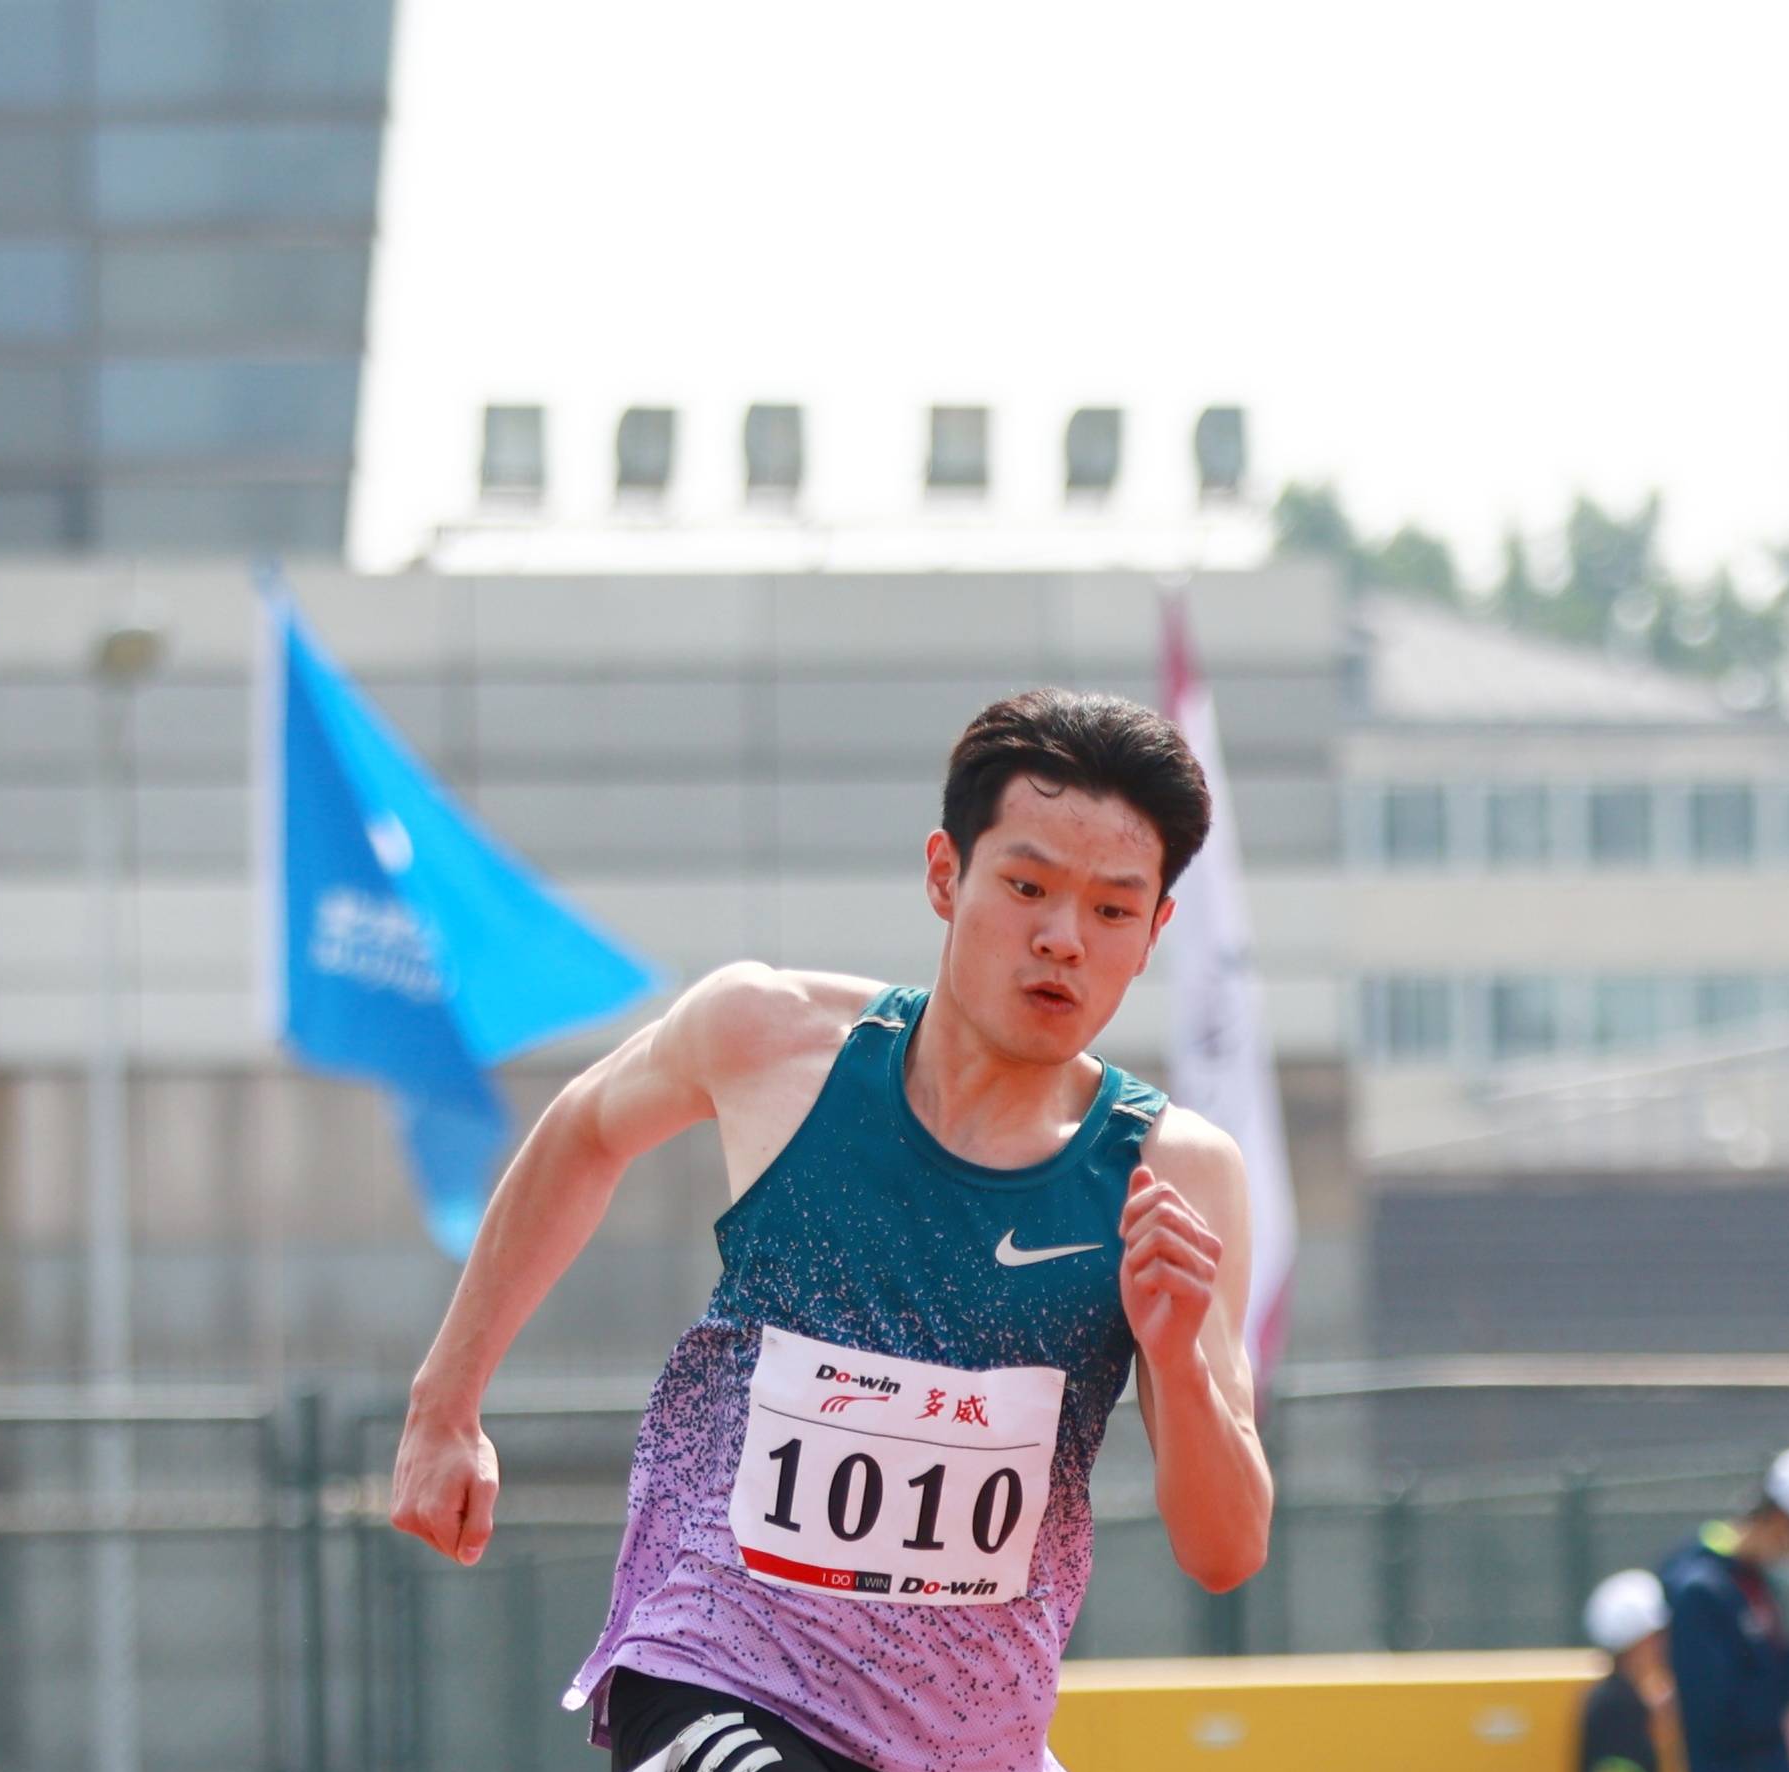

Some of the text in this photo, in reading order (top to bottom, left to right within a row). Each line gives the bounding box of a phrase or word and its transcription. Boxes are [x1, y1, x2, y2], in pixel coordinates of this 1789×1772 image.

[815, 1363, 902, 1395] Do-win
[915, 1388, 989, 1427] 多威
[763, 1437, 1024, 1555] 1010
[831, 1573, 851, 1586] DO
[864, 1576, 889, 1590] WIN
[899, 1576, 999, 1596] Do-win
